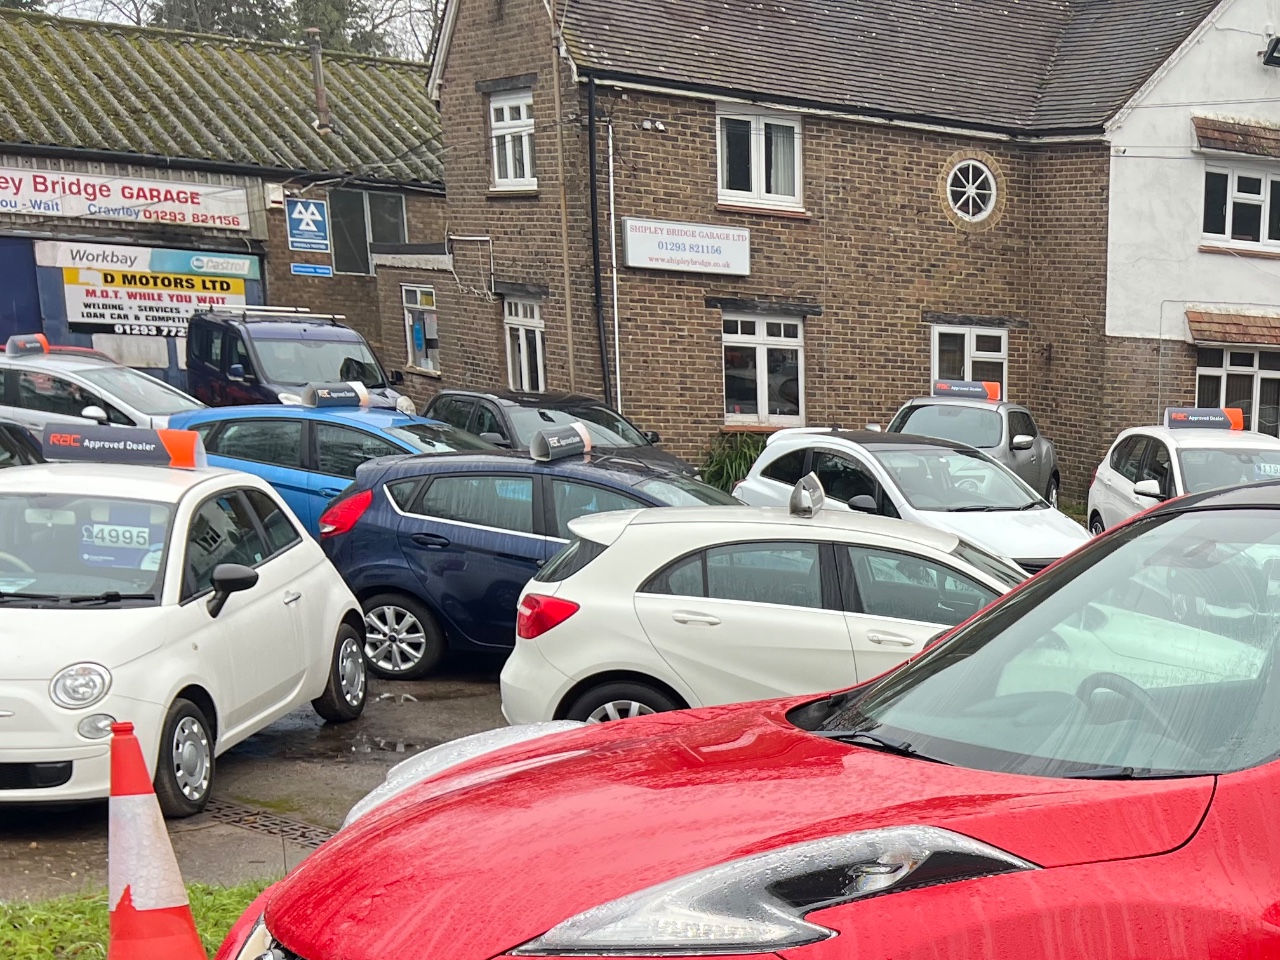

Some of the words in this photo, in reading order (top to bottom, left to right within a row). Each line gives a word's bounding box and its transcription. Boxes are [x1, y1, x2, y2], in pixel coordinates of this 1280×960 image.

[32, 174, 111, 202] Bridge
[121, 186, 201, 205] GARAGE
[29, 199, 60, 212] Wait
[87, 203, 140, 219] Crawley
[143, 209, 186, 222] 01293
[192, 213, 240, 227] 821156
[629, 224, 664, 234] SHIPLEY
[666, 229, 697, 238] BRIDGE
[698, 231, 731, 241] GARAGE
[732, 233, 747, 242] LTD
[657, 240, 687, 252] 01293
[689, 243, 722, 255] 821156
[70, 249, 138, 267] Workbay
[205, 258, 246, 272] Castrol
[122, 274, 195, 289] MOTORS
[201, 279, 231, 292] LTD
[126, 291, 163, 302] WHILE
[167, 293, 192, 303] YOU
[196, 295, 226, 305] WAIT
[83, 302, 124, 311] WELDING
[138, 305, 181, 314] SERVICES
[81, 311, 105, 319] LOAN
[110, 312, 129, 321] CAR
[114, 324, 156, 336] 01293
[83, 438, 124, 450] Approved
[126, 440, 156, 451] Dealer
